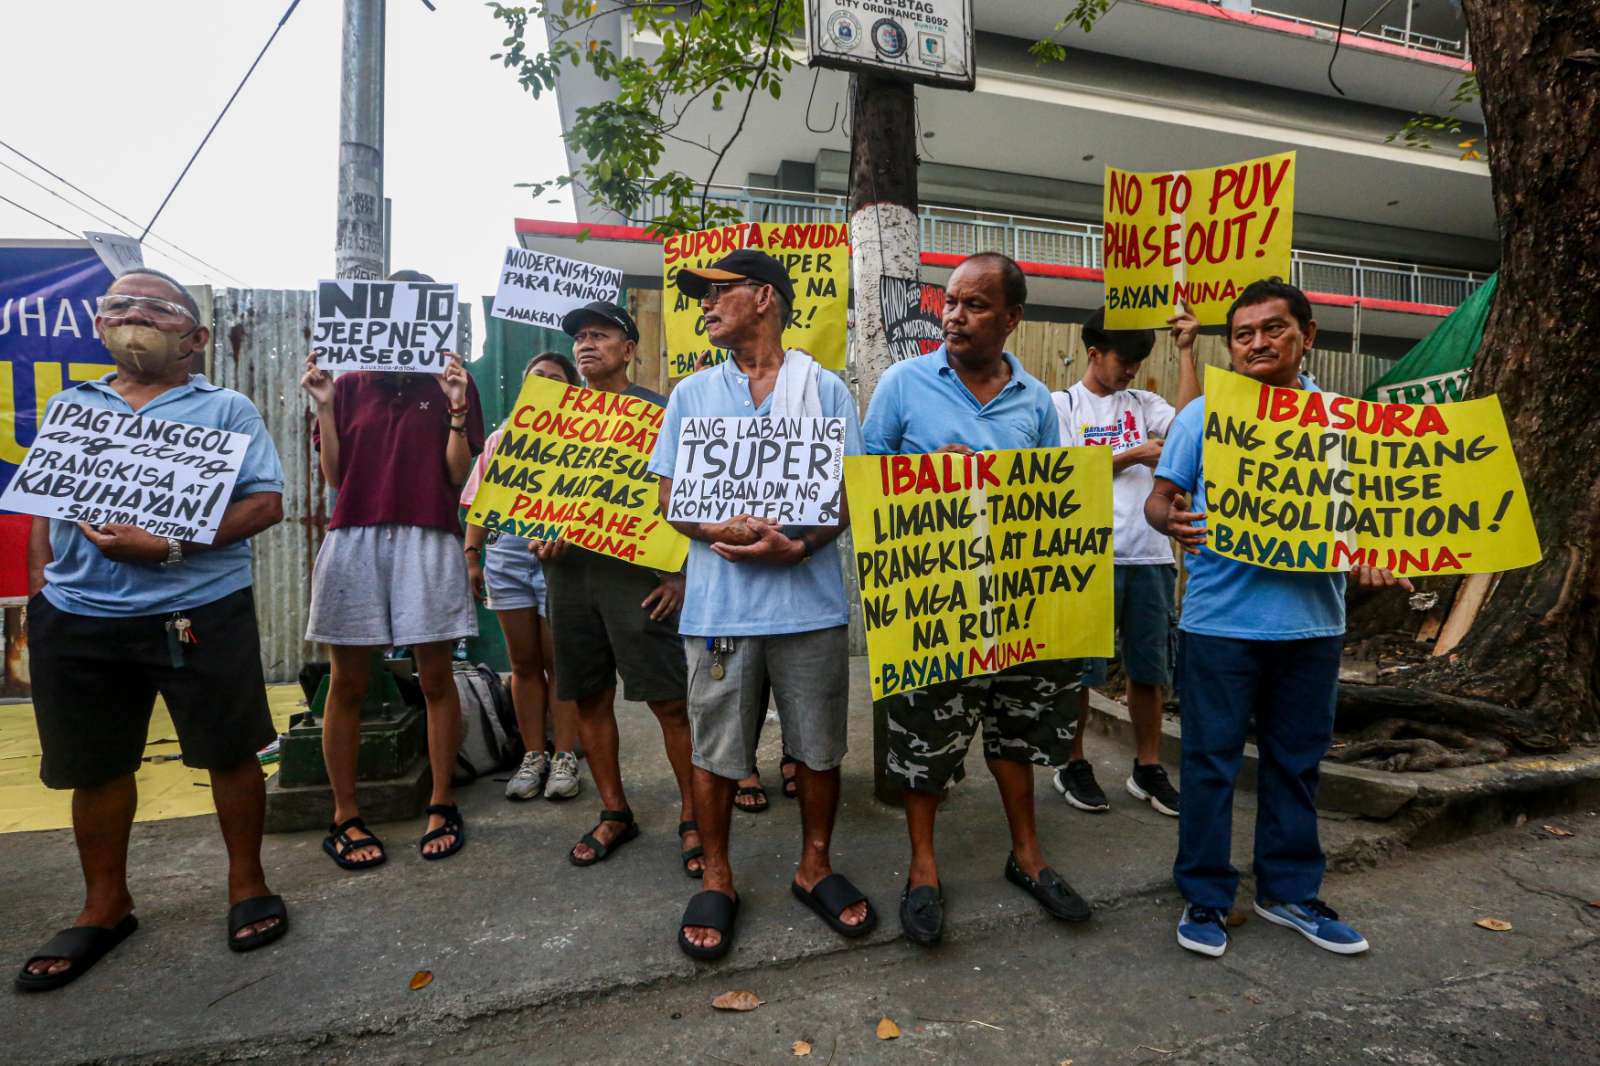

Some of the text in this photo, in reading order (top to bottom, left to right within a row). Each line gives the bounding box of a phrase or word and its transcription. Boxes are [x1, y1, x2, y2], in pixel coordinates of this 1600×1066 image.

[863, 3, 923, 21] ORDINANCE
[1109, 159, 1291, 216] NO TO PUV
[664, 223, 764, 264] SUPORTA
[781, 223, 849, 249] AYUDA
[503, 271, 617, 301] PARA KANINO?
[505, 249, 621, 288] MODERNISASYON
[806, 277, 837, 297] NA
[319, 282, 455, 321] NO TO
[313, 321, 453, 350] JEEPNEY
[49, 403, 233, 455] IPAGTANGGOL
[513, 405, 660, 454] CONSOLIDAT
[682, 417, 726, 439] ANG
[736, 417, 802, 440] LABAN
[812, 418, 843, 442] NG
[1256, 384, 1449, 437] IBASURA
[682, 439, 833, 481] TSUPER
[1204, 412, 1499, 468] ANG SAPILITANG
[27, 448, 209, 496] PRANGKISA AT
[485, 459, 648, 508] MAS MATAAS
[674, 478, 820, 502] AY LABAN DIN NG
[880, 451, 1074, 496] IBALIK ANG
[1238, 457, 1442, 501] FRANCHISE
[13, 470, 225, 527] KABUHAYAN!
[508, 494, 659, 541] PAMASAHE!
[1204, 480, 1514, 539] CONSOLIDATION!
[857, 527, 1112, 591] PRANGKISA AT LAHAT
[864, 564, 1097, 631] NG MGA KINATAY
[913, 598, 1036, 651] NA RUTA!
